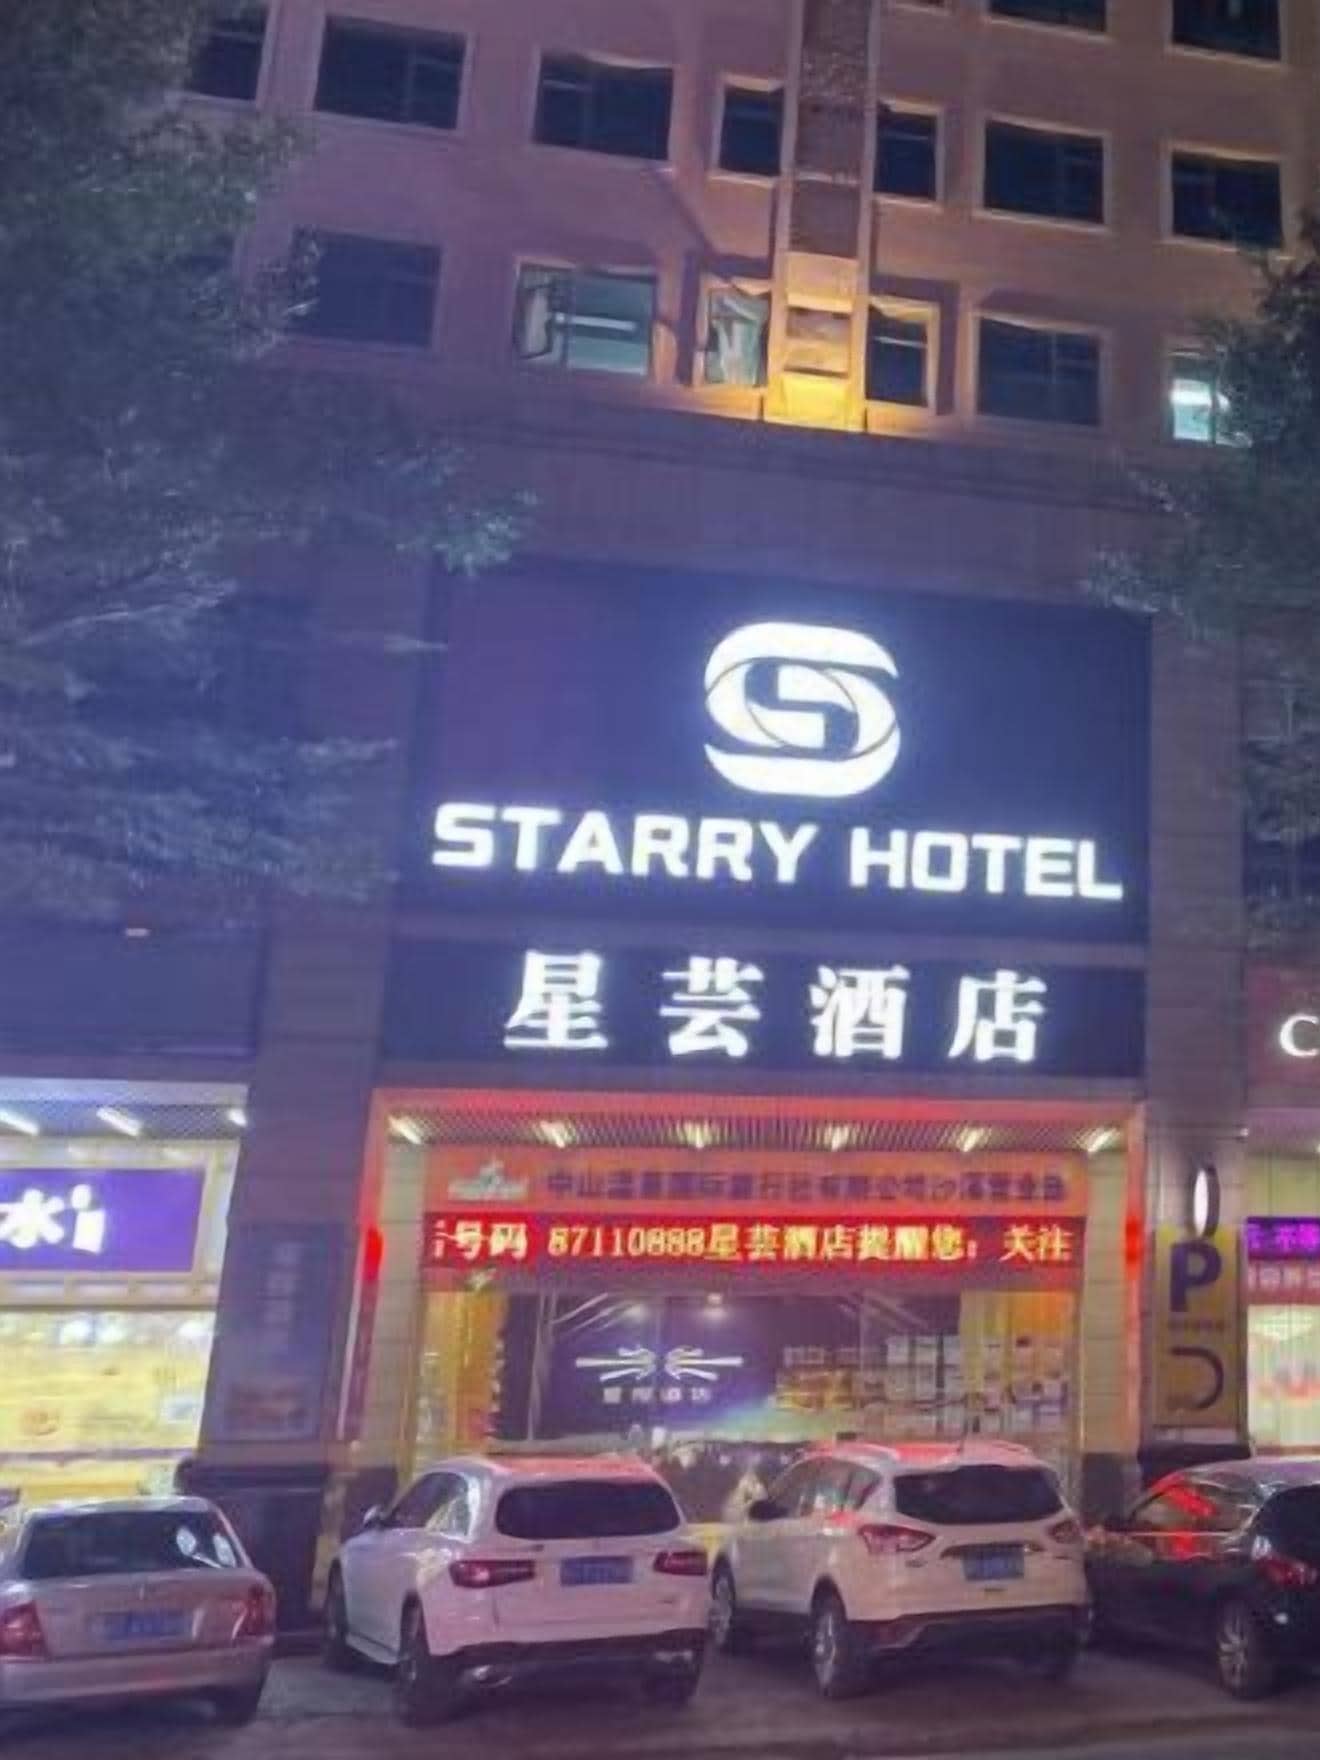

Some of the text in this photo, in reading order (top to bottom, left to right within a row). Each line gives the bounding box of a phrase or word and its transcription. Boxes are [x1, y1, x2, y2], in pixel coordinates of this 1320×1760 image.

[432, 801, 1124, 902] STARRY HOTEL
[503, 949, 1048, 1063] 星芸酒店
[998, 1222, 1074, 1263] 关注
